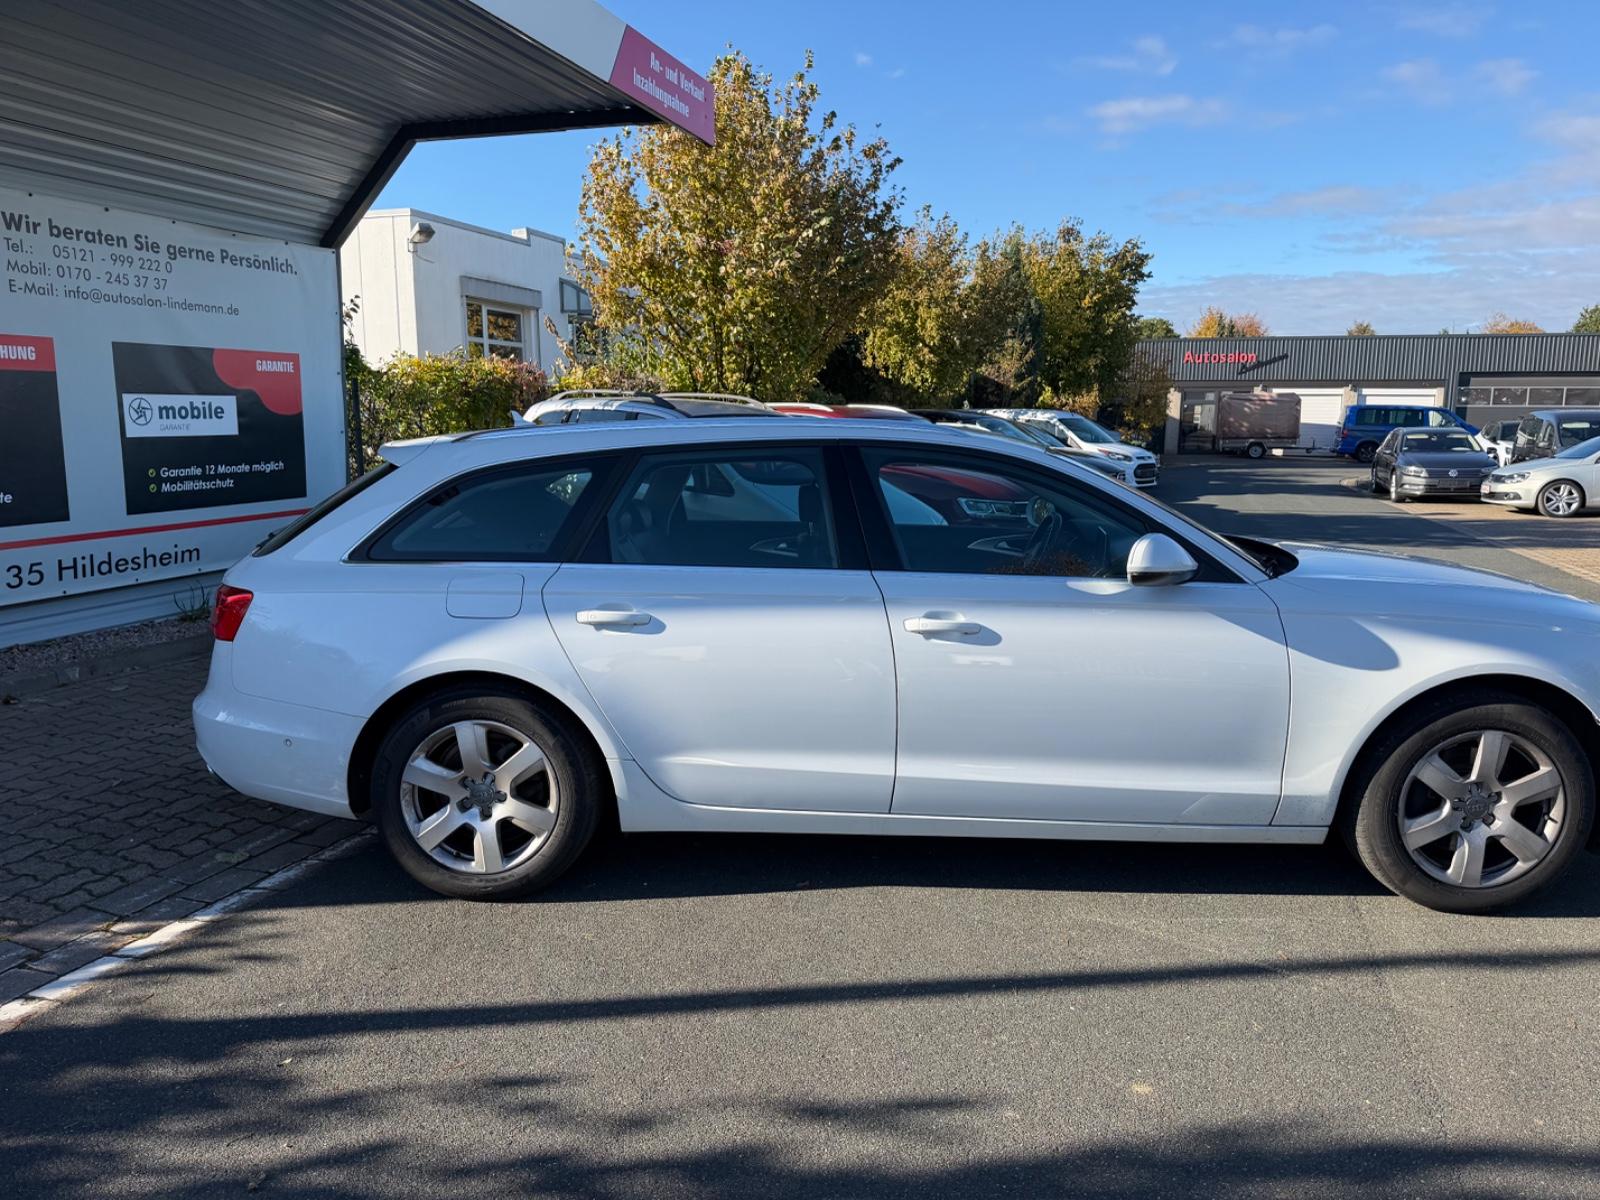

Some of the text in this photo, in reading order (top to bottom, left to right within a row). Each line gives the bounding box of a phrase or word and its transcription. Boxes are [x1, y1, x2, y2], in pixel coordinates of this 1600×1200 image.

[665, 66, 679, 85] und
[679, 71, 705, 103] Verkauf
[0, 211, 298, 276] Wir beraten Sie gerne Persönlich.
[4, 237, 33, 254] Tel.:
[52, 244, 94, 262] 05121
[110, 253, 134, 269] 999
[138, 257, 161, 272] 222
[165, 261, 173, 274] 0
[6, 259, 51, 277] Mobil:
[56, 264, 92, 281] 0170
[105, 271, 130, 286] 245
[134, 274, 149, 289] 37
[153, 277, 168, 290] 37
[8, 279, 240, 316] E-Mail: info@autosalon-lindemann.de
[256, 359, 294, 373] GARANTIE
[1183, 350, 1257, 364] Autosalon
[158, 401, 225, 420] mobile
[160, 423, 191, 432] GARANTIE
[160, 461, 285, 478] Garantie 12 Monate möglich
[161, 478, 234, 493] Mobilitätsschutz
[6, 544, 201, 589] 35 Hildesheim
